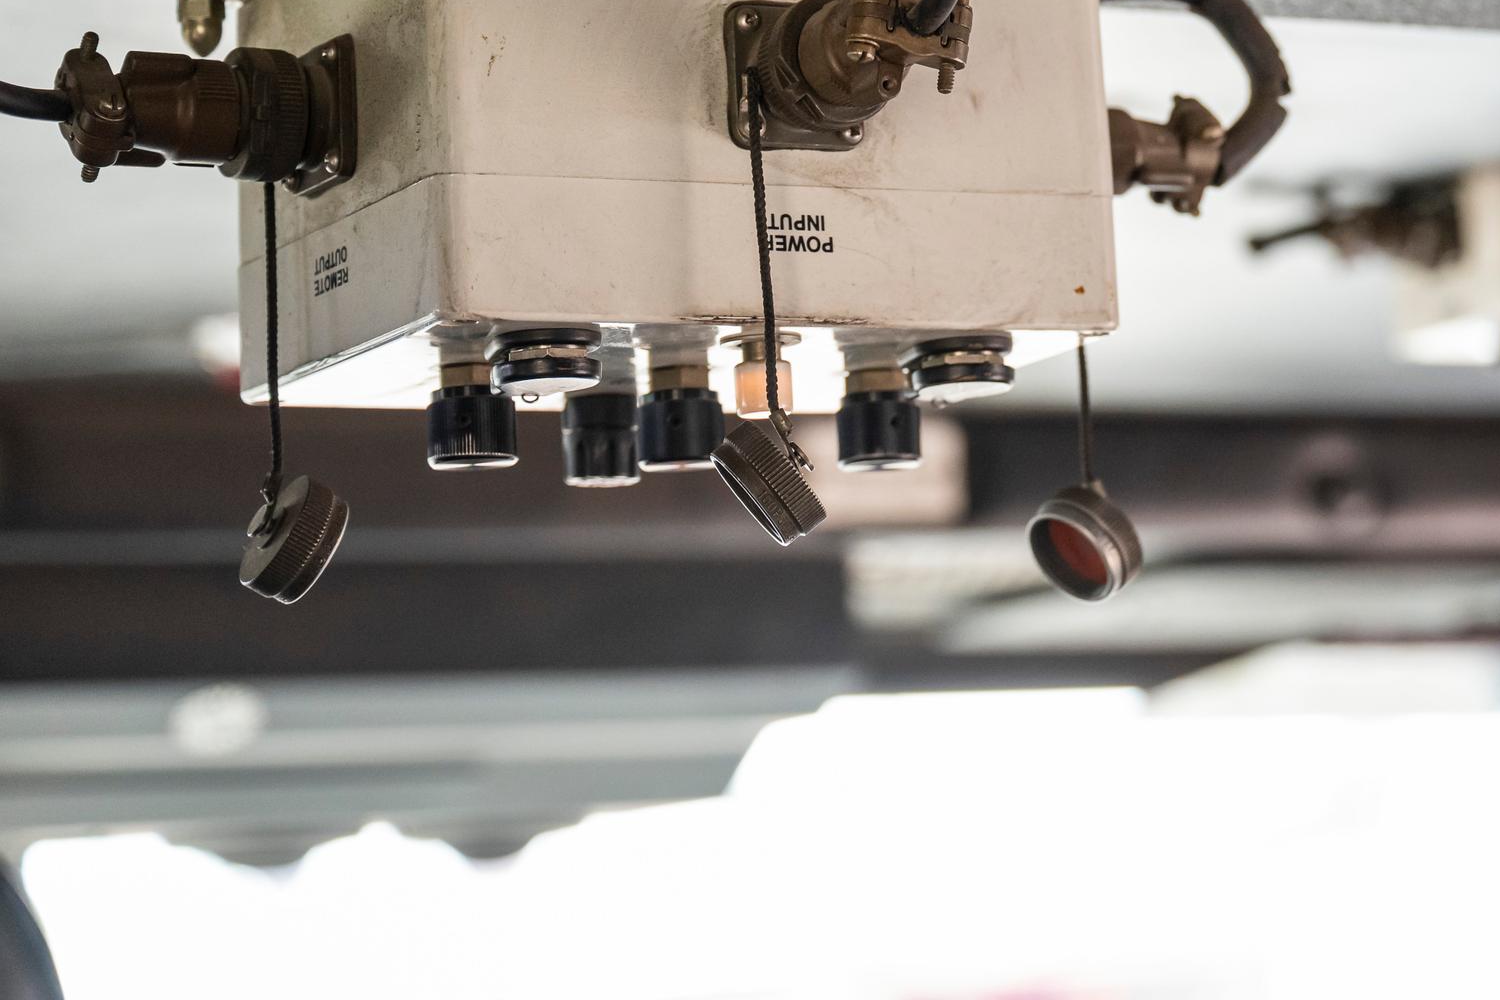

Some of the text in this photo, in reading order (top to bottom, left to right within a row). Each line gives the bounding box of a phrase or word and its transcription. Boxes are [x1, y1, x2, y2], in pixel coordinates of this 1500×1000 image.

[767, 213, 825, 231] INPUT
[314, 245, 348, 276] OUTPUT
[314, 266, 349, 297] REMOTE
